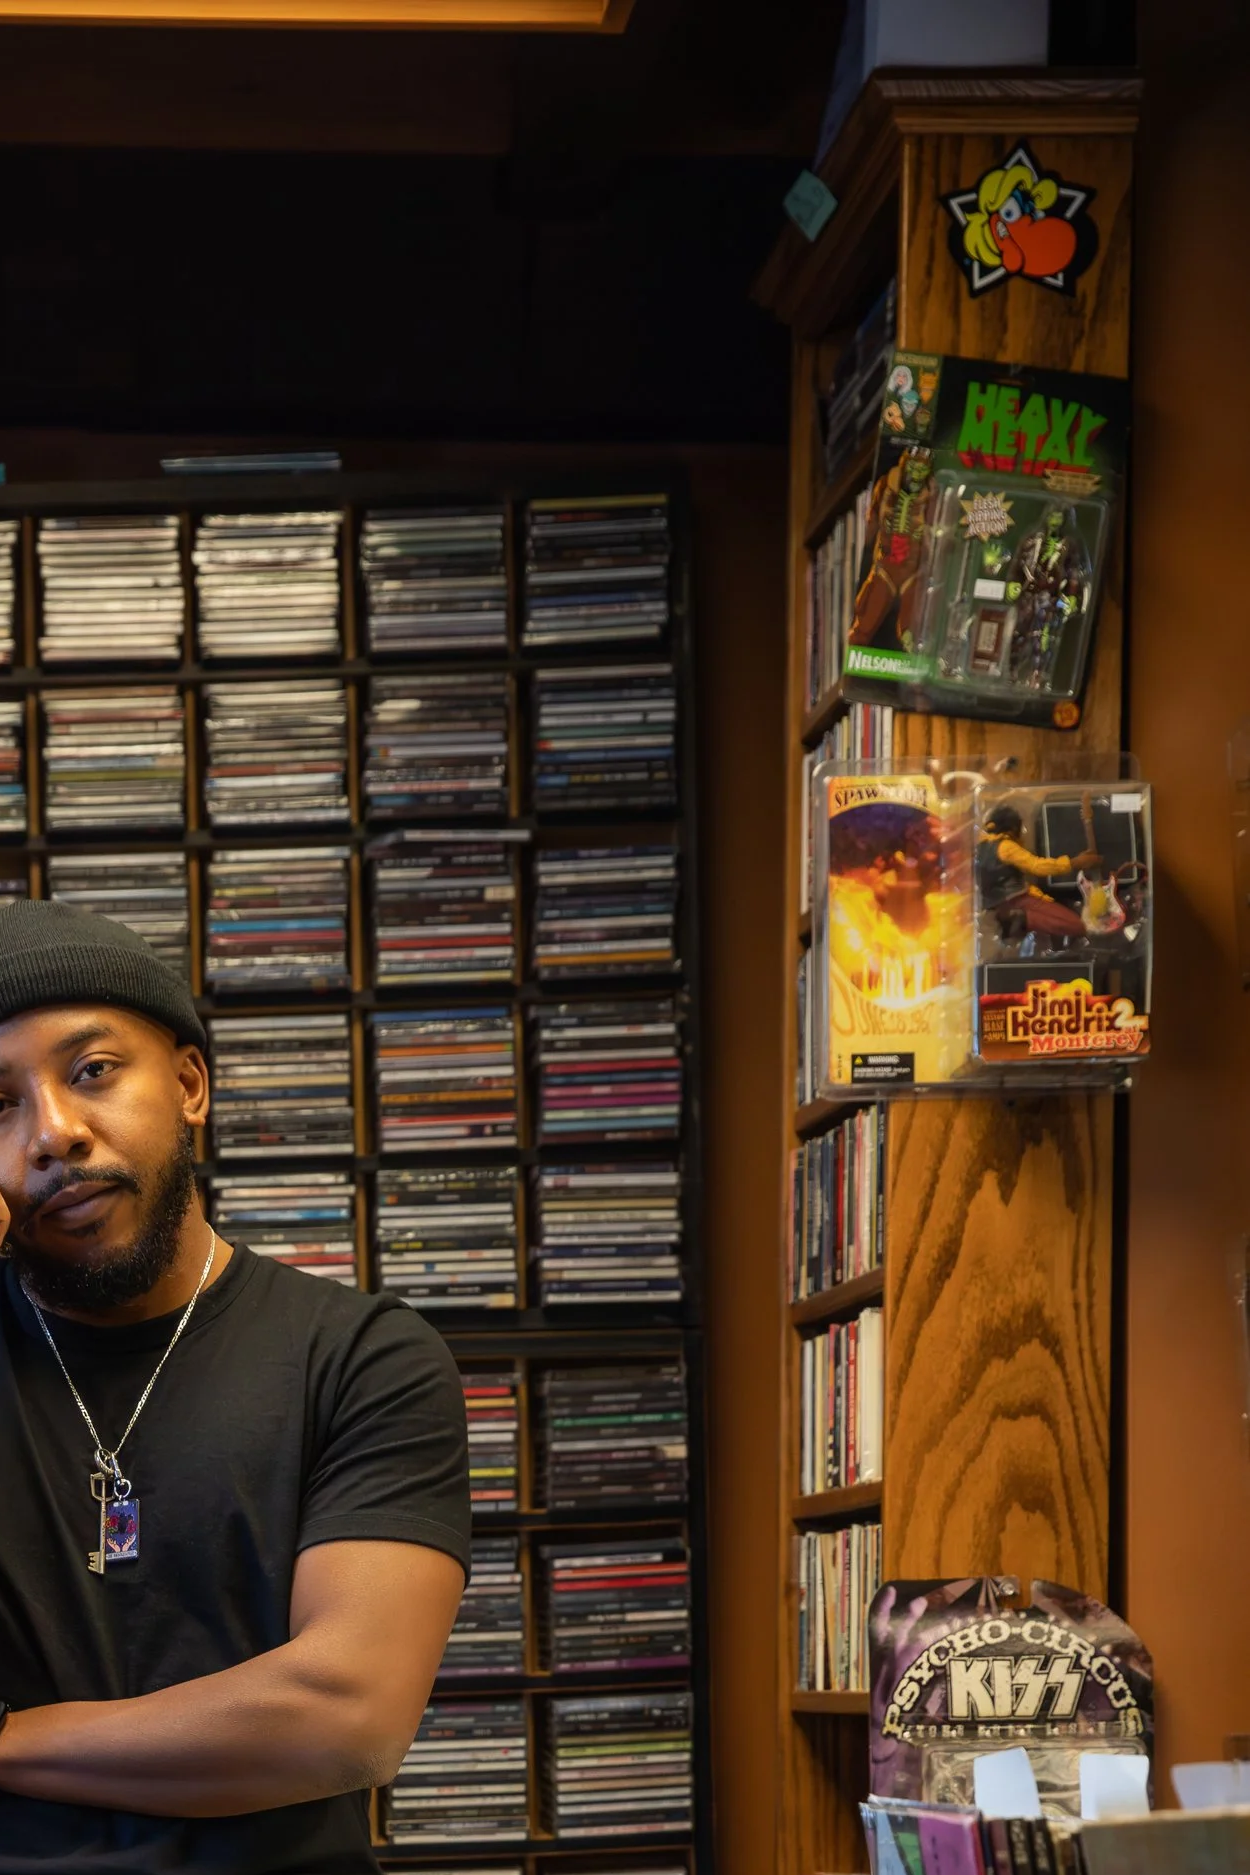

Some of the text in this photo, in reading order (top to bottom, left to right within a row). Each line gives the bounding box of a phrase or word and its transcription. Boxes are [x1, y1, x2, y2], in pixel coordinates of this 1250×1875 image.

[962, 381, 1109, 433] HEAVY
[957, 422, 1097, 472] METAL
[1030, 1030, 1144, 1054] Monterey
[881, 1617, 1145, 1739] PSYCHO-CIRCUS
[947, 1654, 1088, 1721] KISS
